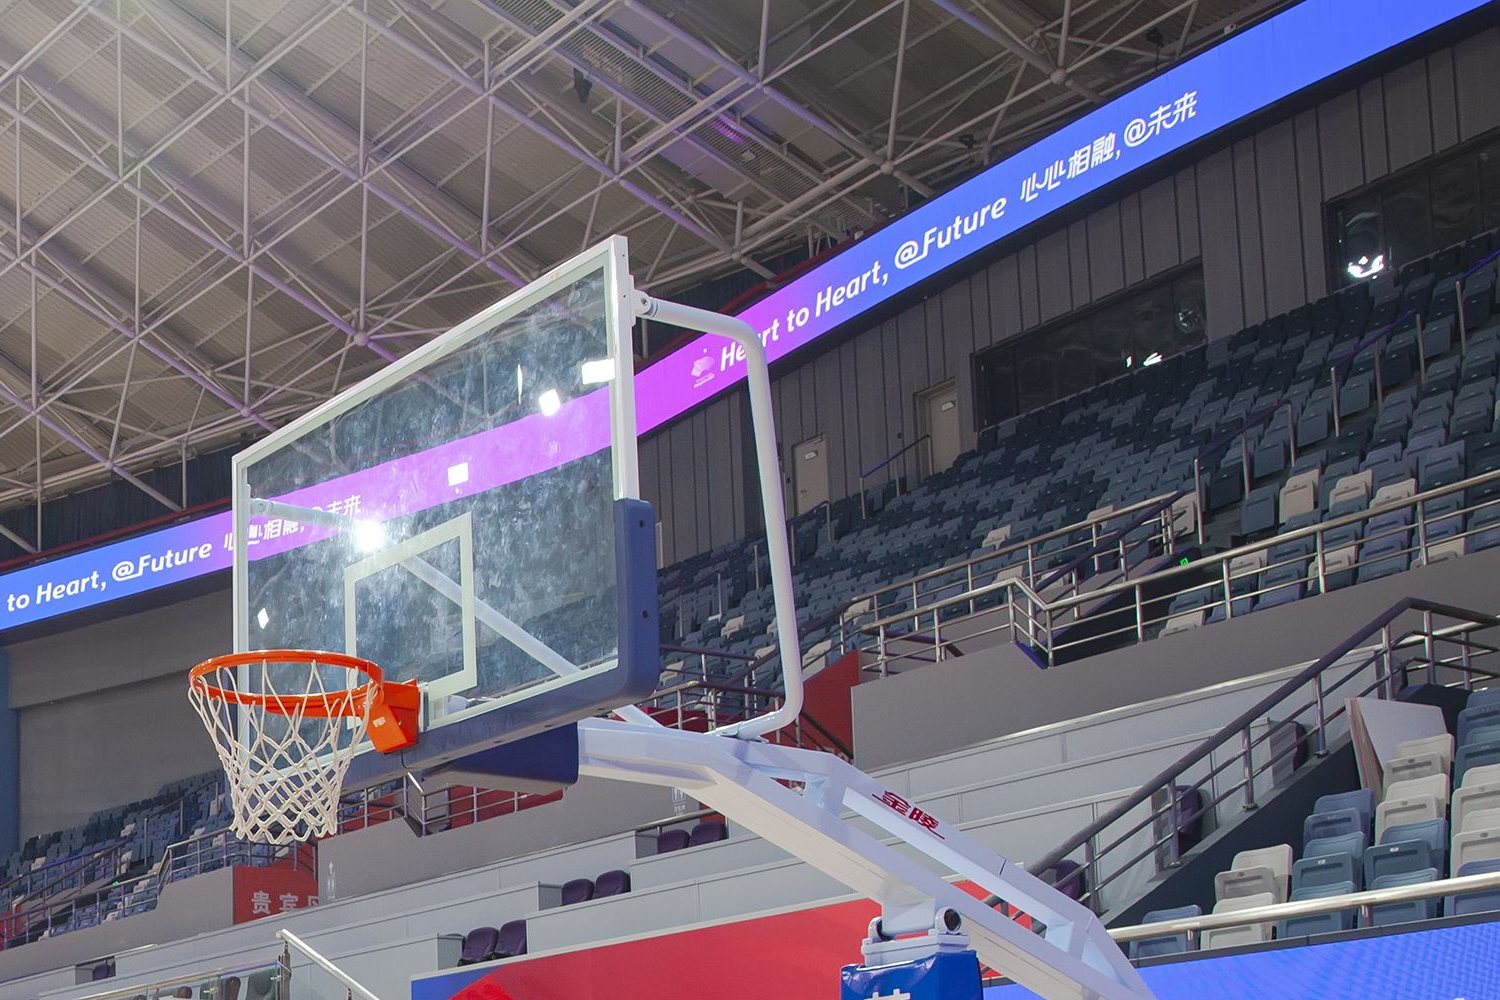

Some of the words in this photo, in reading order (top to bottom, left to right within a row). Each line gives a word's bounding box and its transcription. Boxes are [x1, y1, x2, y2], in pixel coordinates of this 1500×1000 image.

[786, 307, 810, 333] to
[815, 261, 889, 319] Heart,
[894, 197, 1007, 270] @Future
[7, 593, 30, 613] to
[35, 570, 107, 605] Heart,
[111, 542, 213, 582] @Future
